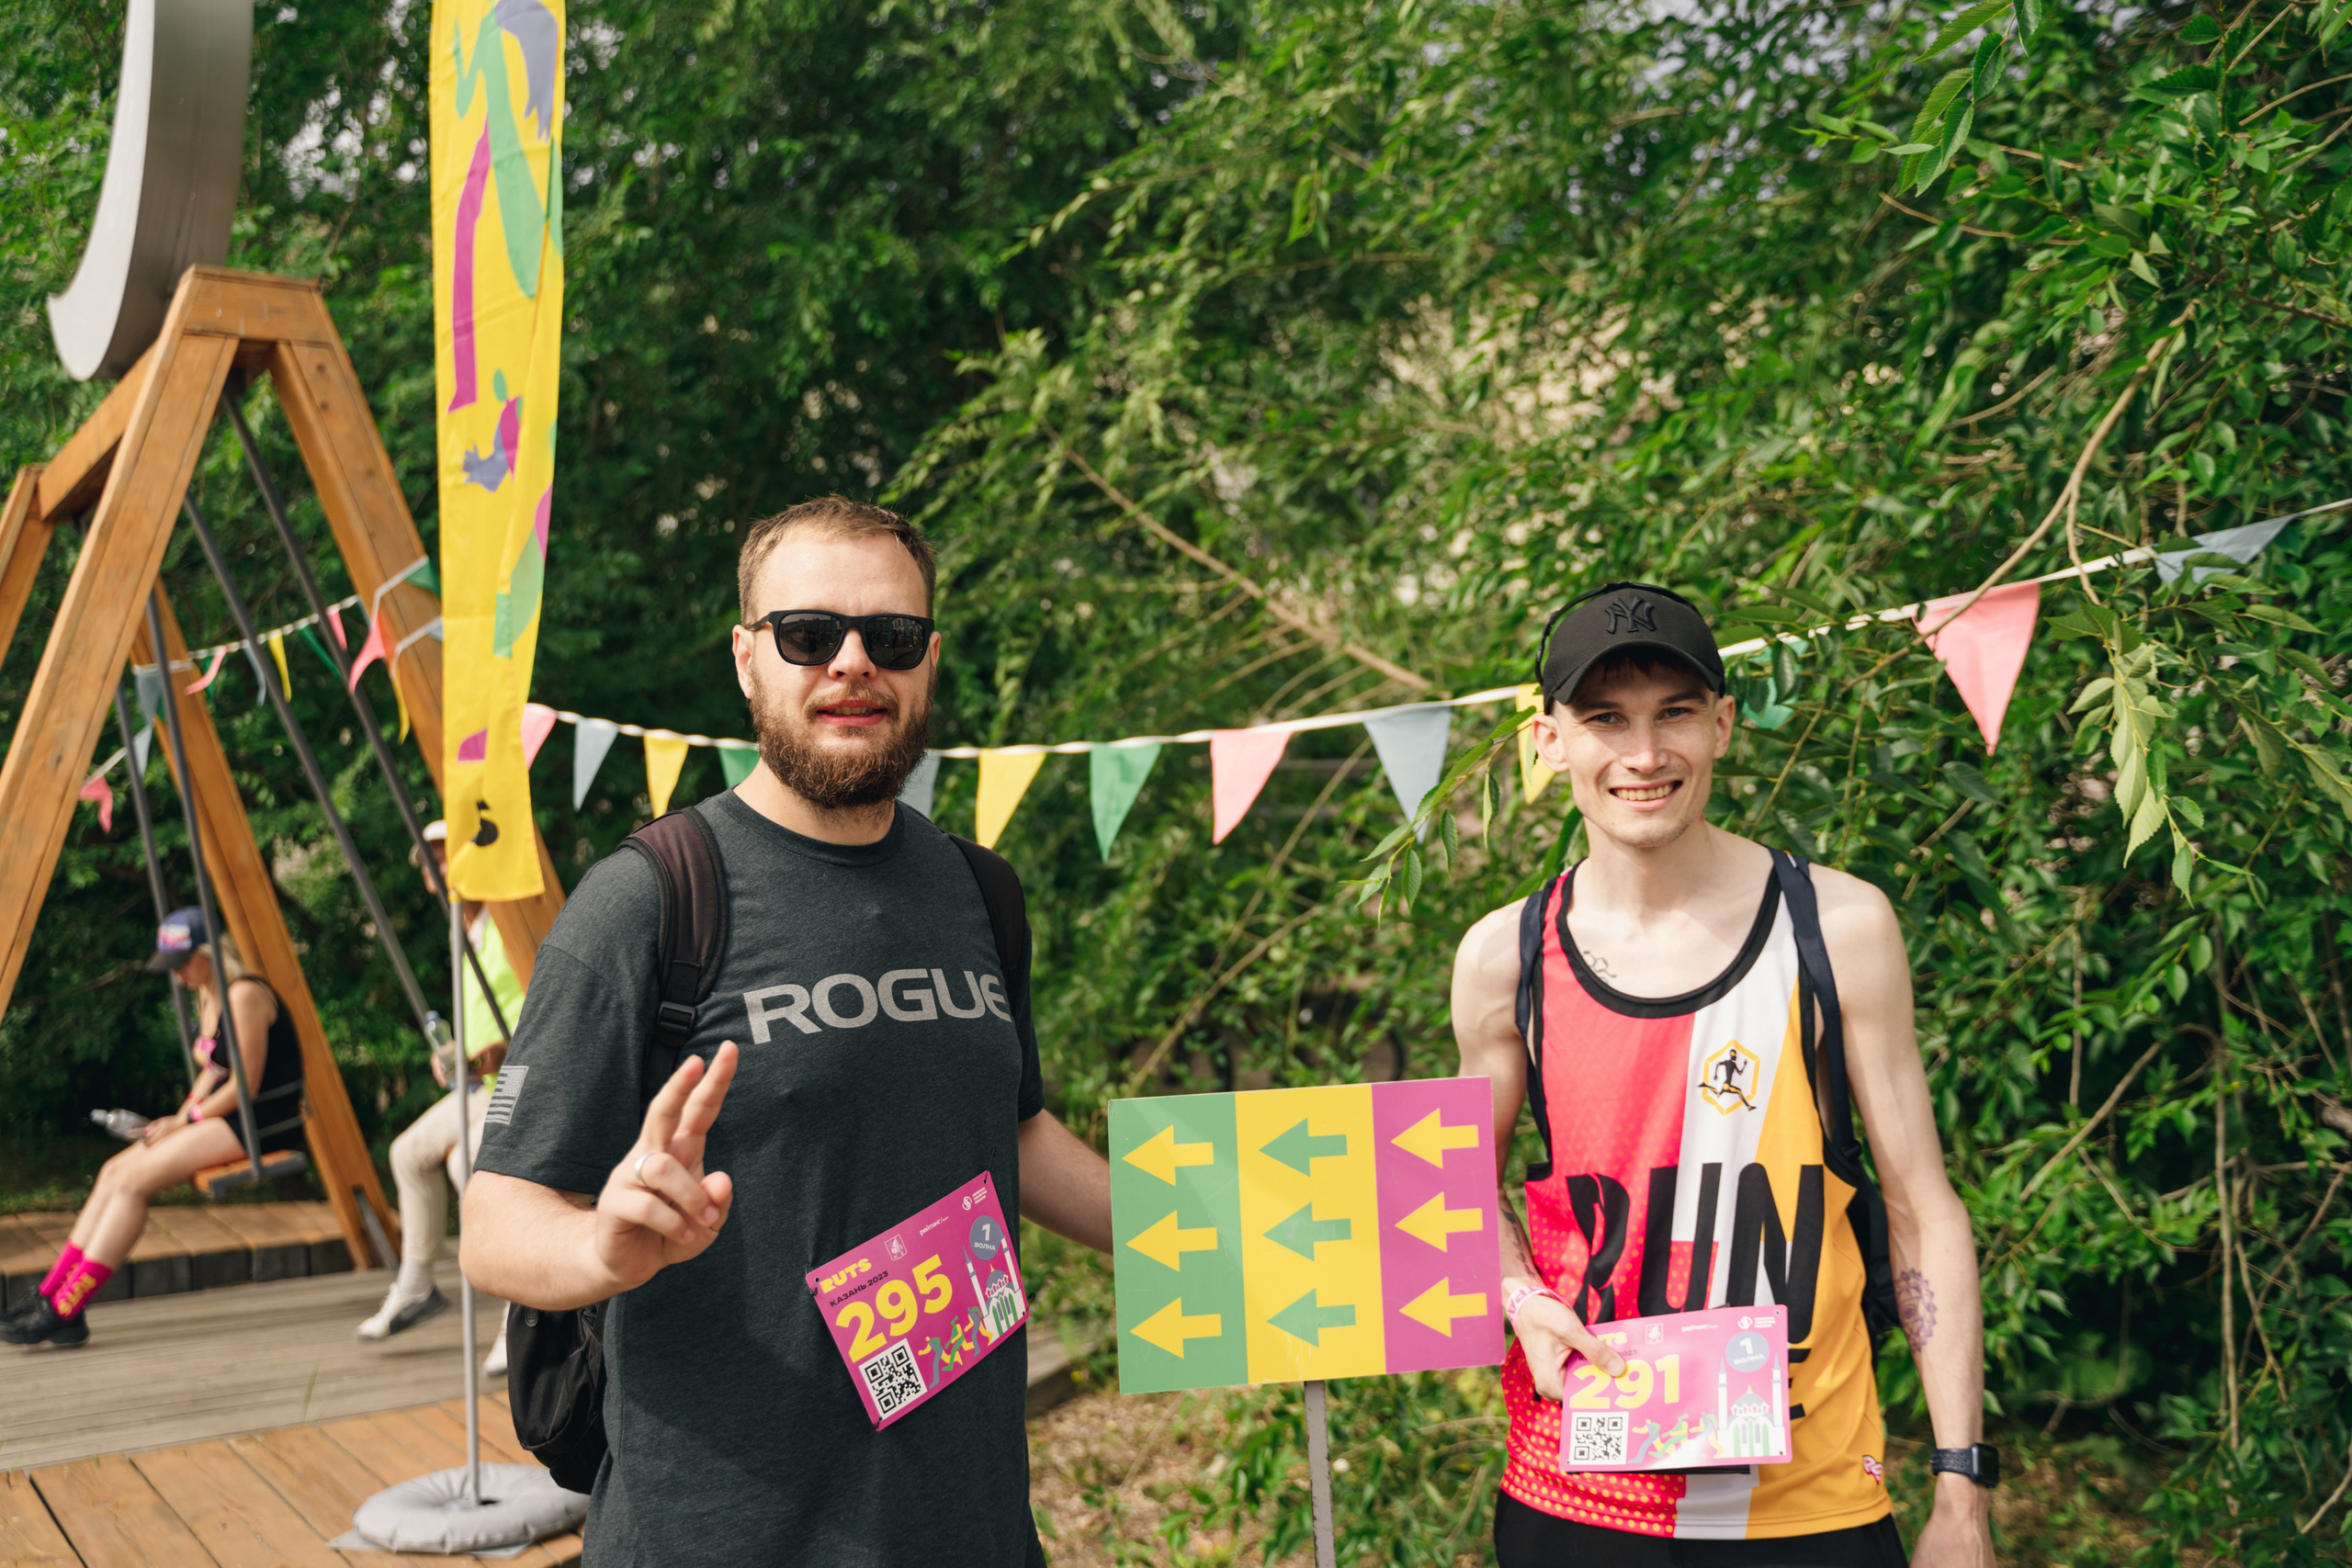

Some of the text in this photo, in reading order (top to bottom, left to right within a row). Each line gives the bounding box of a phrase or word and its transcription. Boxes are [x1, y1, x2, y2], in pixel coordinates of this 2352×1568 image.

[1605, 595, 1657, 634] NY
[742, 968, 1012, 1045] ROGUE
[974, 1241, 996, 1251] ВОЛНА
[982, 1224, 991, 1242] 1
[1566, 1162, 1825, 1344] RUN
[820, 1258, 872, 1294] RUTS
[830, 1270, 889, 1307] КАЗАНЬ 2023
[836, 1253, 953, 1363] 295
[1733, 1353, 1765, 1366] ВОЛНА
[1739, 1337, 1753, 1355] 1
[1569, 1353, 1680, 1410] 291
